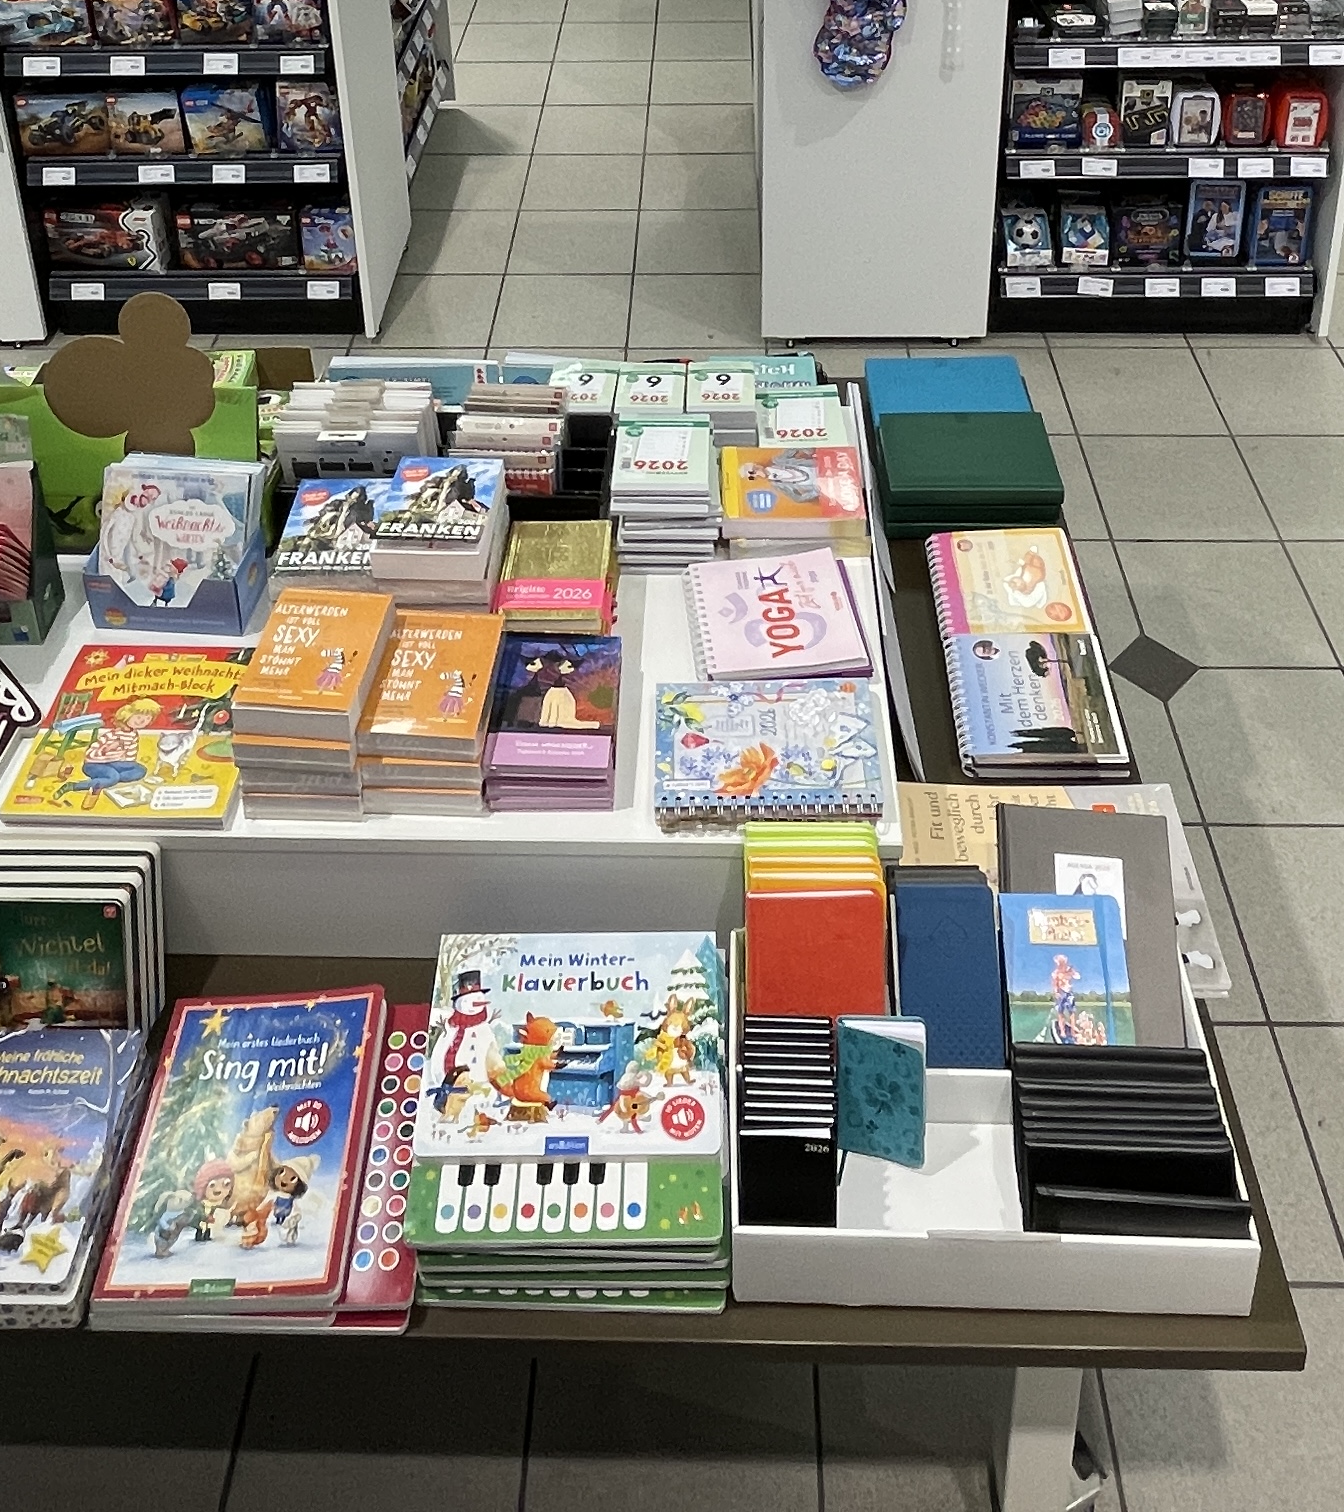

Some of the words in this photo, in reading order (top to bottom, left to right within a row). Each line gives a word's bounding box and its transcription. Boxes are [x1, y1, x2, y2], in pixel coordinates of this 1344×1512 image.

[628, 392, 669, 404] 2026
[700, 391, 741, 403] 2026
[776, 426, 828, 438] 2026
[633, 459, 689, 472] 2026
[376, 522, 481, 537] FRANKEN
[553, 587, 593, 601] 2026
[758, 587, 805, 659] YOGA
[84, 671, 120, 687] Mein
[123, 666, 169, 679] dicker
[1007, 650, 1026, 696] Herzen
[112, 679, 216, 695] Mitmach-Block
[998, 692, 1015, 714] Mit
[1016, 698, 1033, 728] dem
[923, 791, 942, 819] und
[964, 793, 985, 835] durch
[929, 822, 945, 841] Fit
[944, 792, 970, 863] beweglich
[519, 952, 564, 968] Mein
[567, 952, 636, 968] Winter-
[501, 970, 650, 993] Klavierbuch
[33, 1048, 86, 1066] fröhliche
[197, 1049, 260, 1093] Sing
[265, 1042, 330, 1079] mit!
[803, 1142, 830, 1154] 2026
